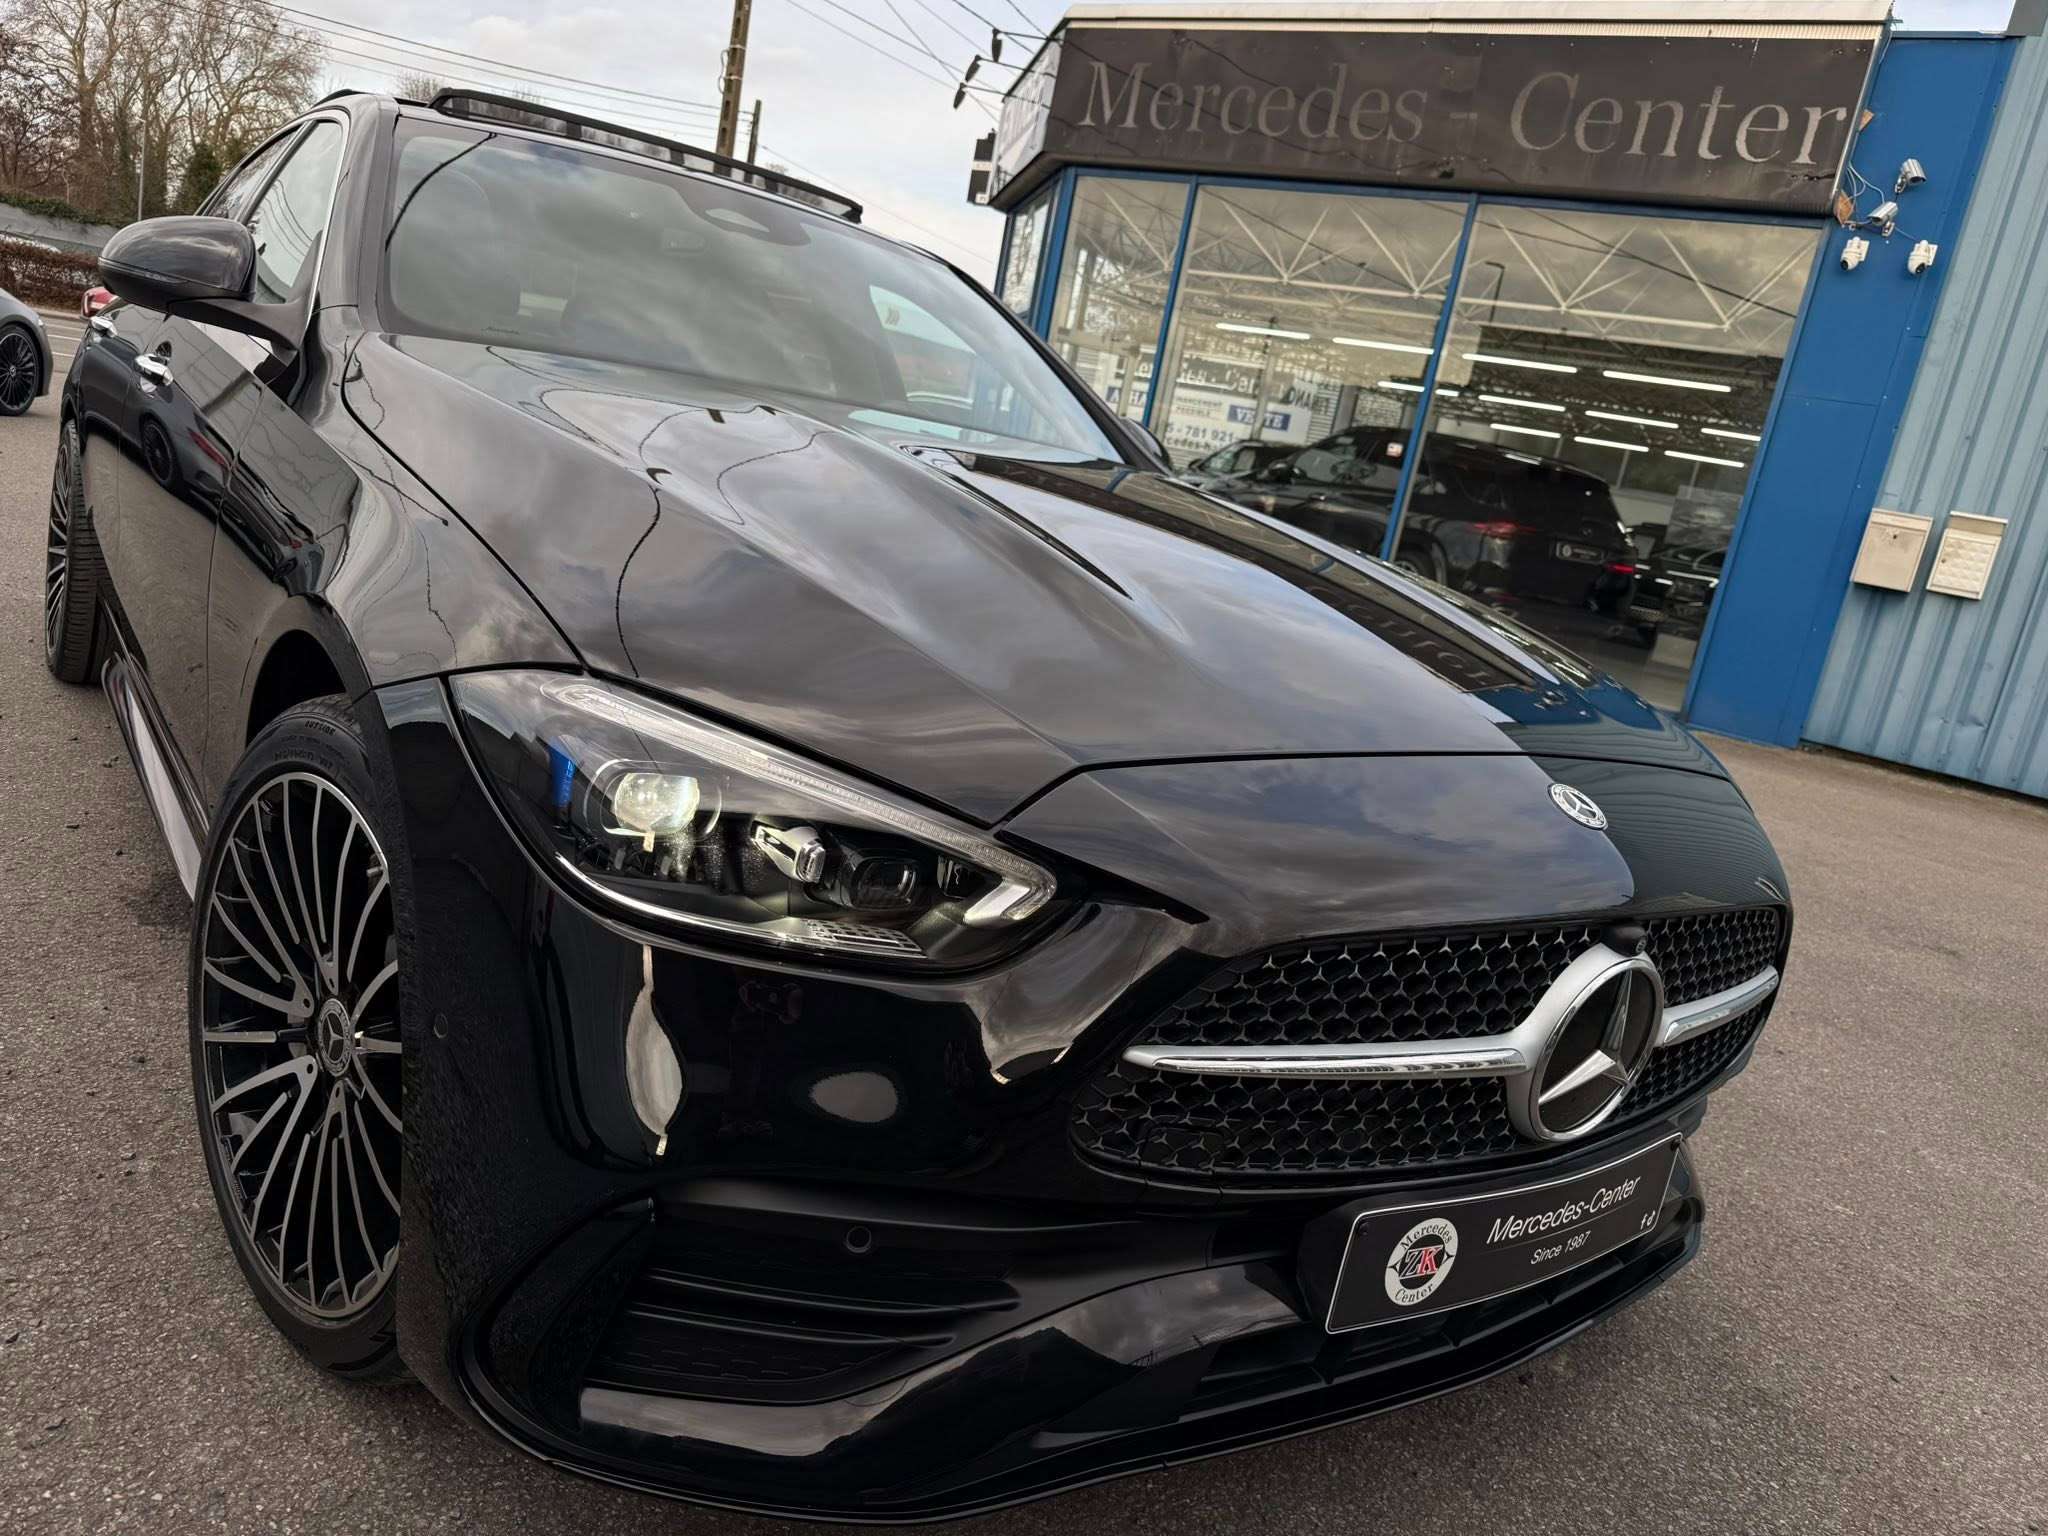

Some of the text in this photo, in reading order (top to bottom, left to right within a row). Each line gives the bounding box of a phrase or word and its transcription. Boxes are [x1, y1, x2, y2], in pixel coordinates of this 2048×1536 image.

[1078, 61, 1427, 143] Mercedes
[1510, 71, 1848, 166] Center
[1235, 407, 1285, 428] VETE
[1186, 425, 1207, 439] 781
[1486, 1175, 1642, 1245] Mercedes-Center
[1400, 1224, 1453, 1251] Mercedes
[1530, 1230, 1592, 1265] Since 1987
[1394, 1283, 1433, 1304] Center
